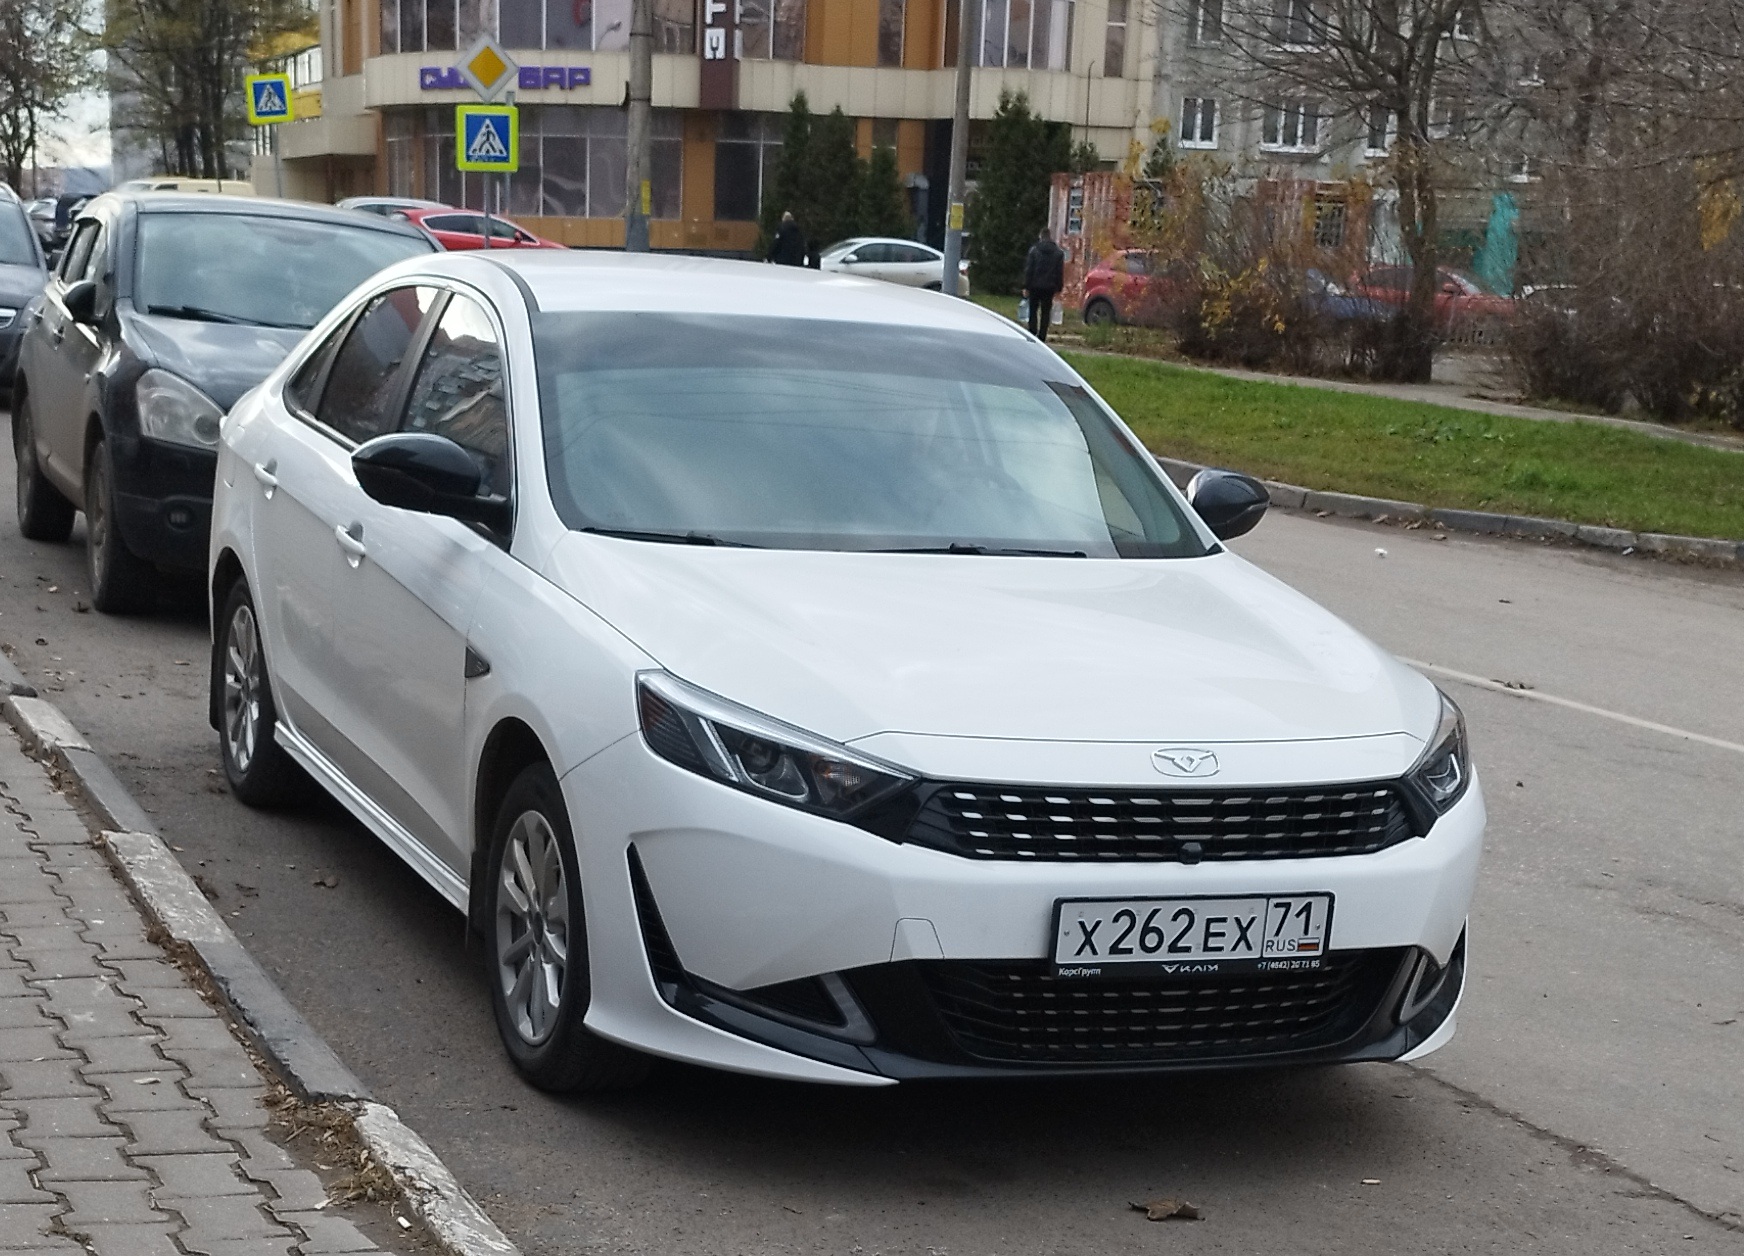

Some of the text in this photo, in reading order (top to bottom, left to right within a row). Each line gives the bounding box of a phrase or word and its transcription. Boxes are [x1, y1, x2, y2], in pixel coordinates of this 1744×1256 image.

[519, 66, 591, 90] БАР
[1273, 901, 1313, 937] 71
[1265, 939, 1296, 953] RUS
